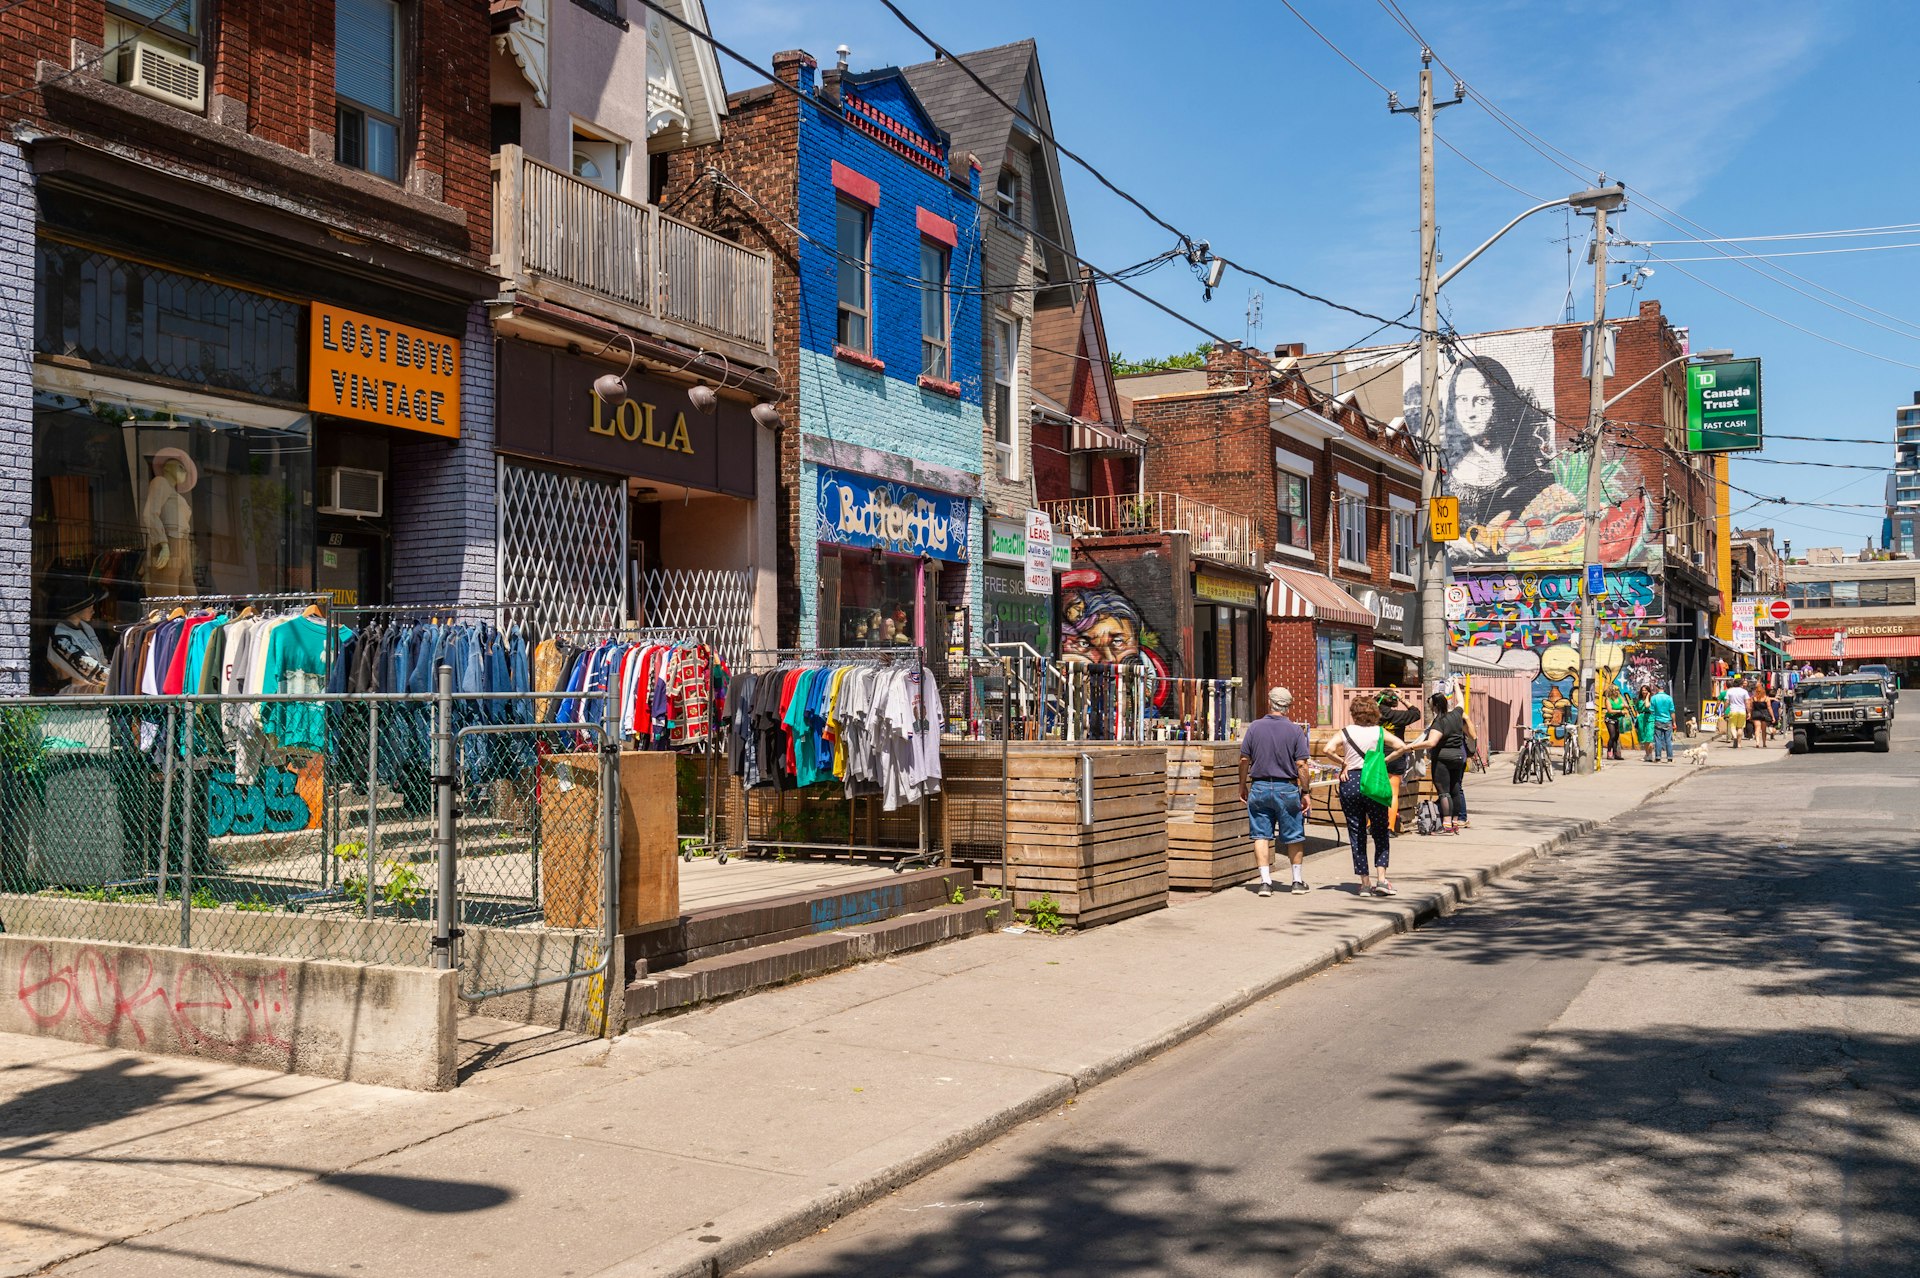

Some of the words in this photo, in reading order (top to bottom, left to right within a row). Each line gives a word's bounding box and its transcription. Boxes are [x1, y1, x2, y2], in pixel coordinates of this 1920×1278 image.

[323, 314, 391, 363] LOST
[396, 332, 454, 377] BOYS
[1697, 373, 1714, 385] TD
[330, 369, 445, 426] VINTAGE
[1702, 387, 1751, 399] Canada
[1703, 398, 1739, 410] Trust
[588, 388, 695, 455] LOLA
[1725, 420, 1747, 428] CASH
[1437, 505, 1449, 518] NO
[836, 485, 949, 552] Butterfly
[1029, 527, 1050, 542] LEASE
[1435, 522, 1453, 535] EXIT
[984, 576, 1008, 594] FREE
[1847, 627, 1870, 635] MEAT
[1871, 625, 1904, 634] LOCKER
